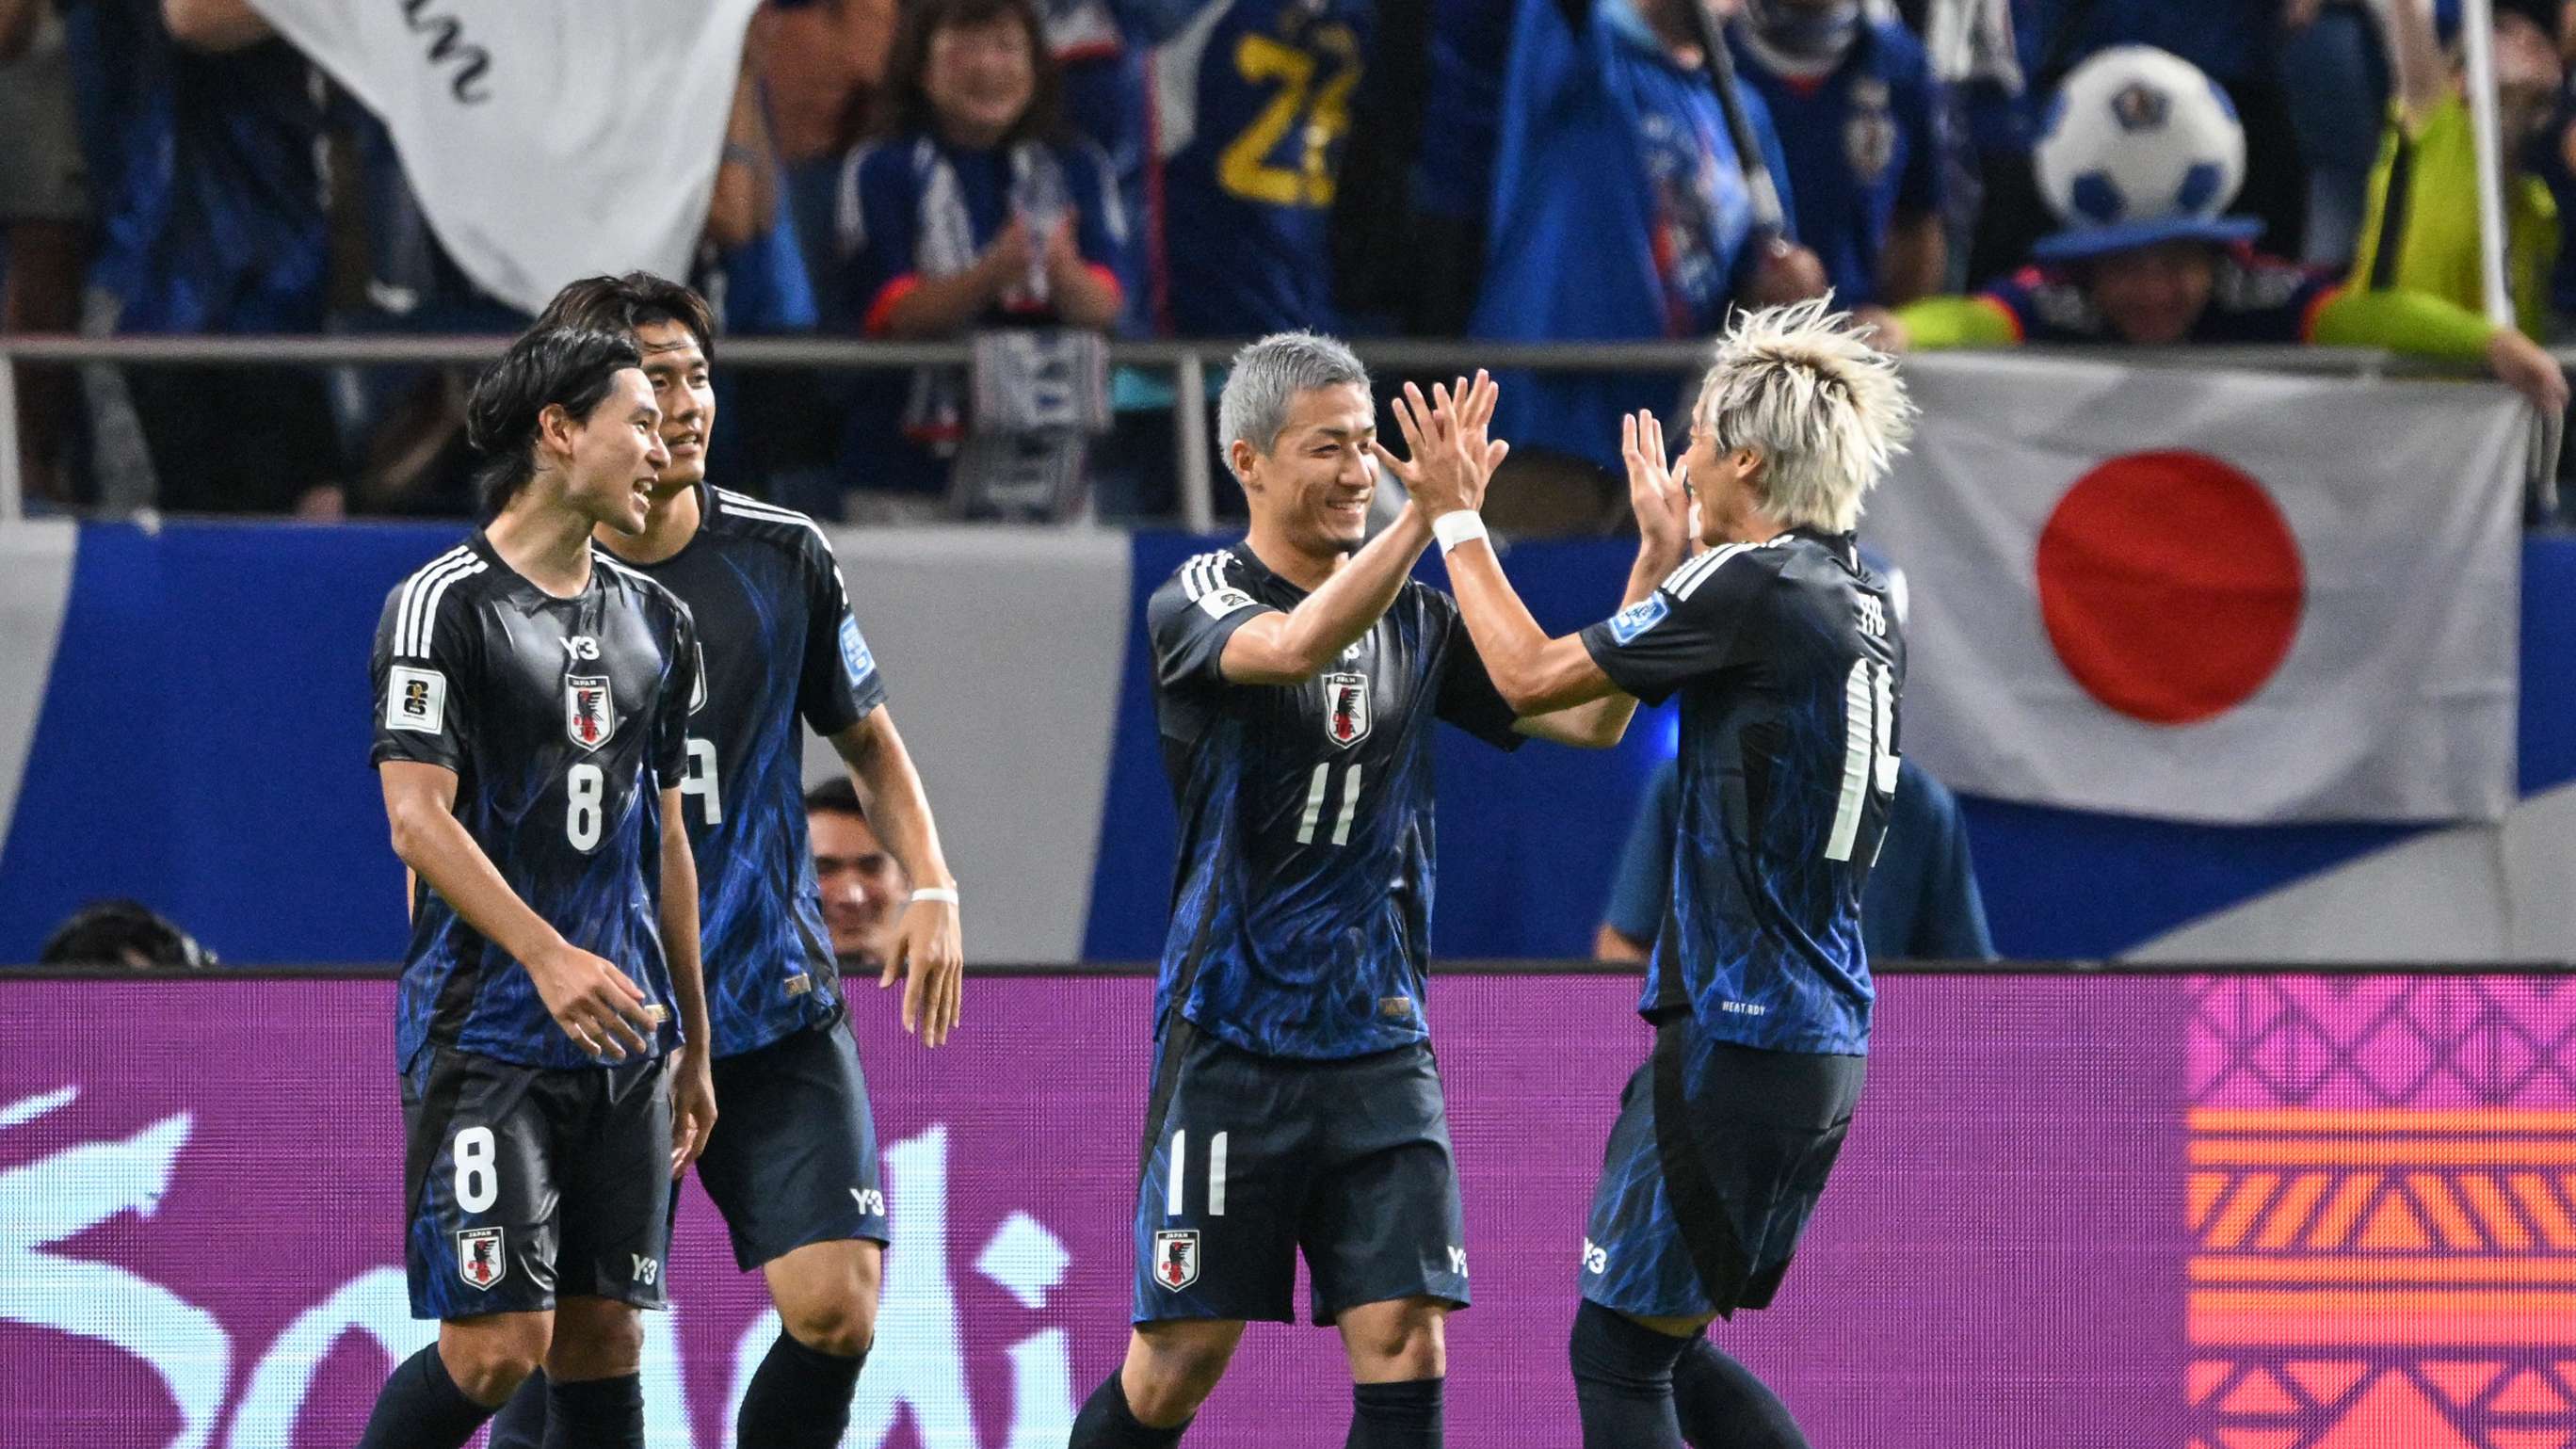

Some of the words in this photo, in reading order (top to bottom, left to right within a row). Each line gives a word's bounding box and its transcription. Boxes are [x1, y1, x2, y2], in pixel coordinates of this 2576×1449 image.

[567, 763, 604, 851] 8
[1296, 762, 1361, 845] 11
[454, 1126, 498, 1215] 8
[1167, 1129, 1228, 1216] 11
